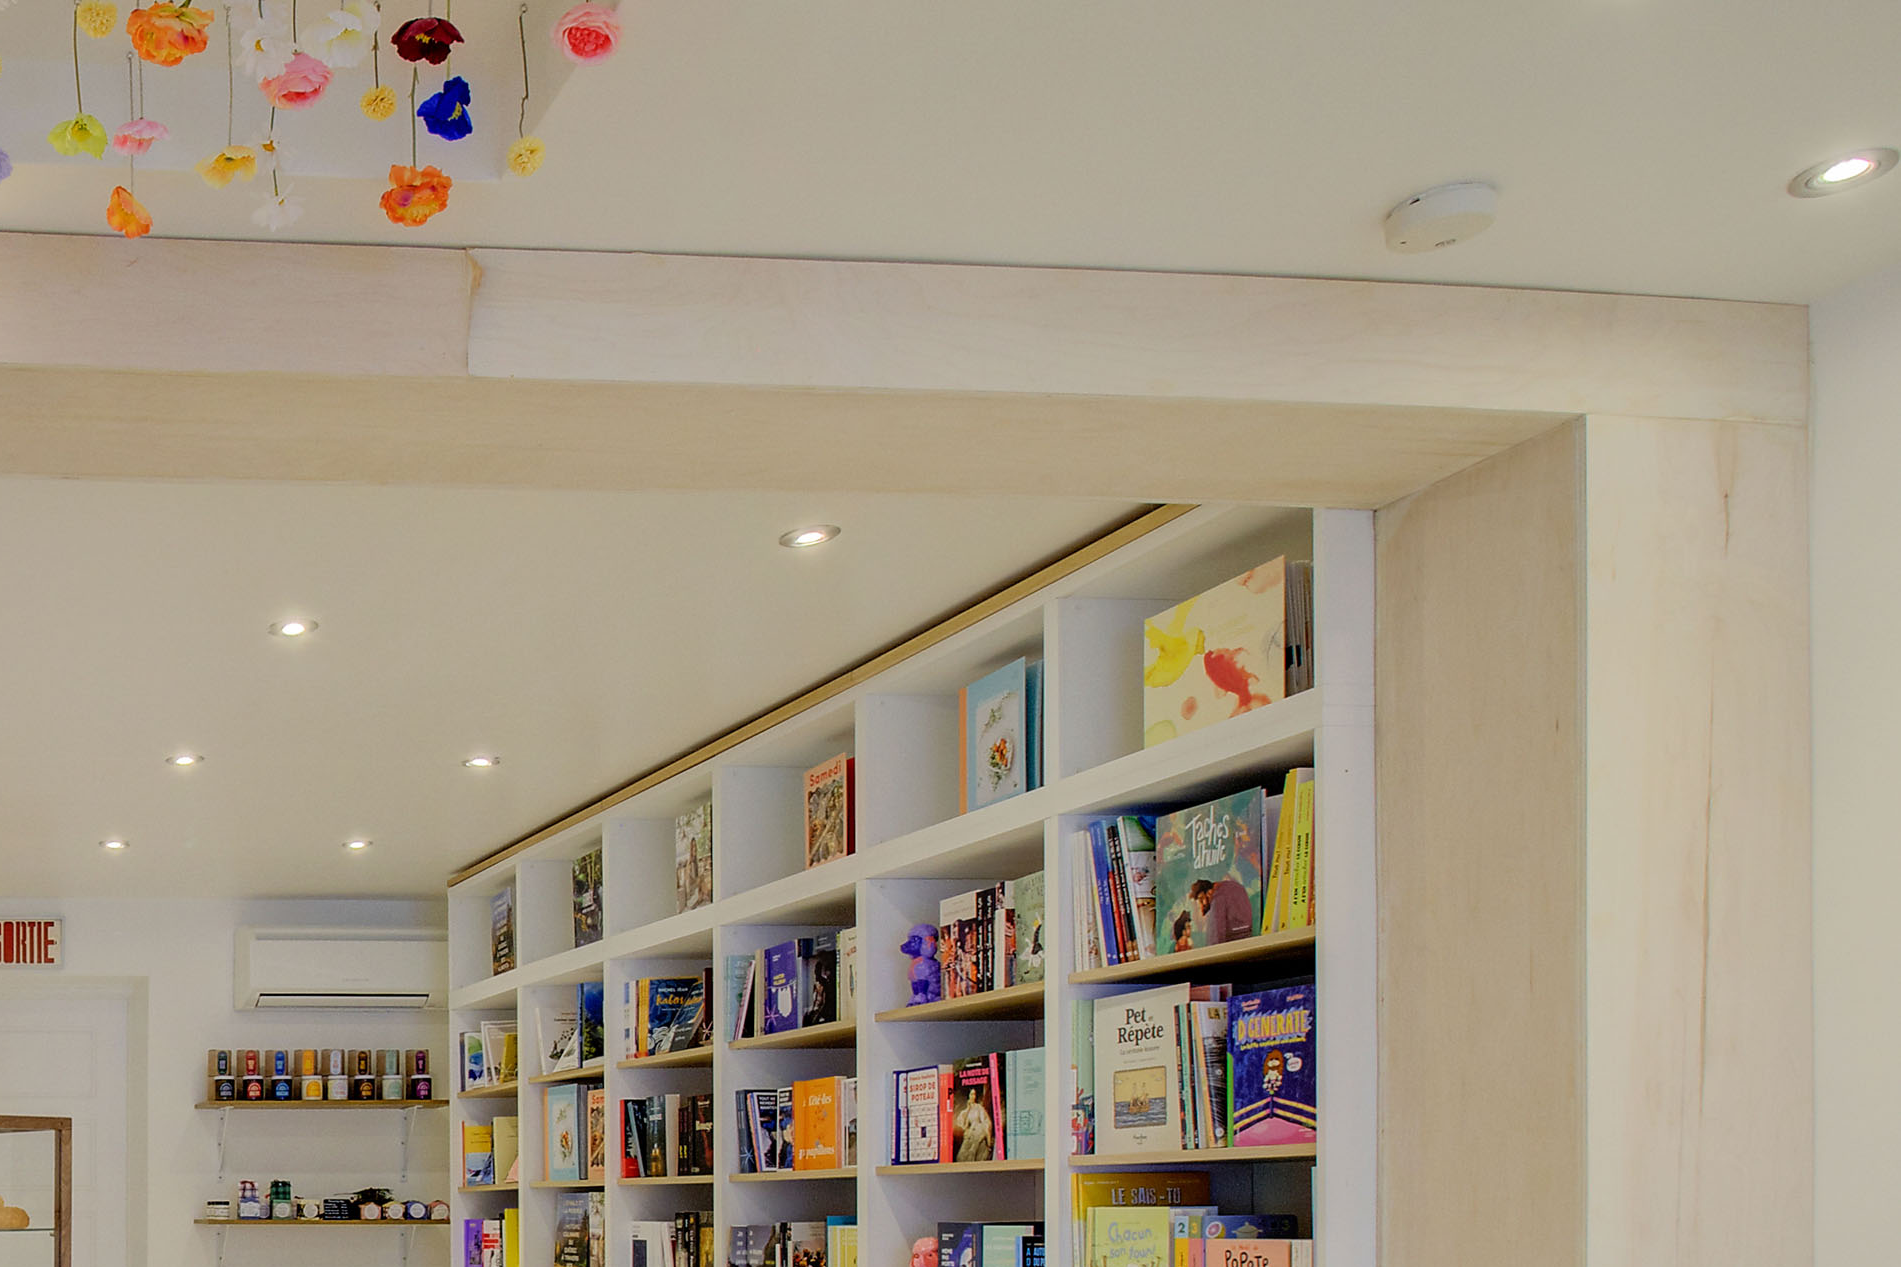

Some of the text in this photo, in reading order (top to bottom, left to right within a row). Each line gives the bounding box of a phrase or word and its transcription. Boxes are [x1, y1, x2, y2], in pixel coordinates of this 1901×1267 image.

[1125, 1007, 1147, 1025] Pet
[1117, 1023, 1164, 1045] Répète
[1107, 1221, 1154, 1243] Chacun
